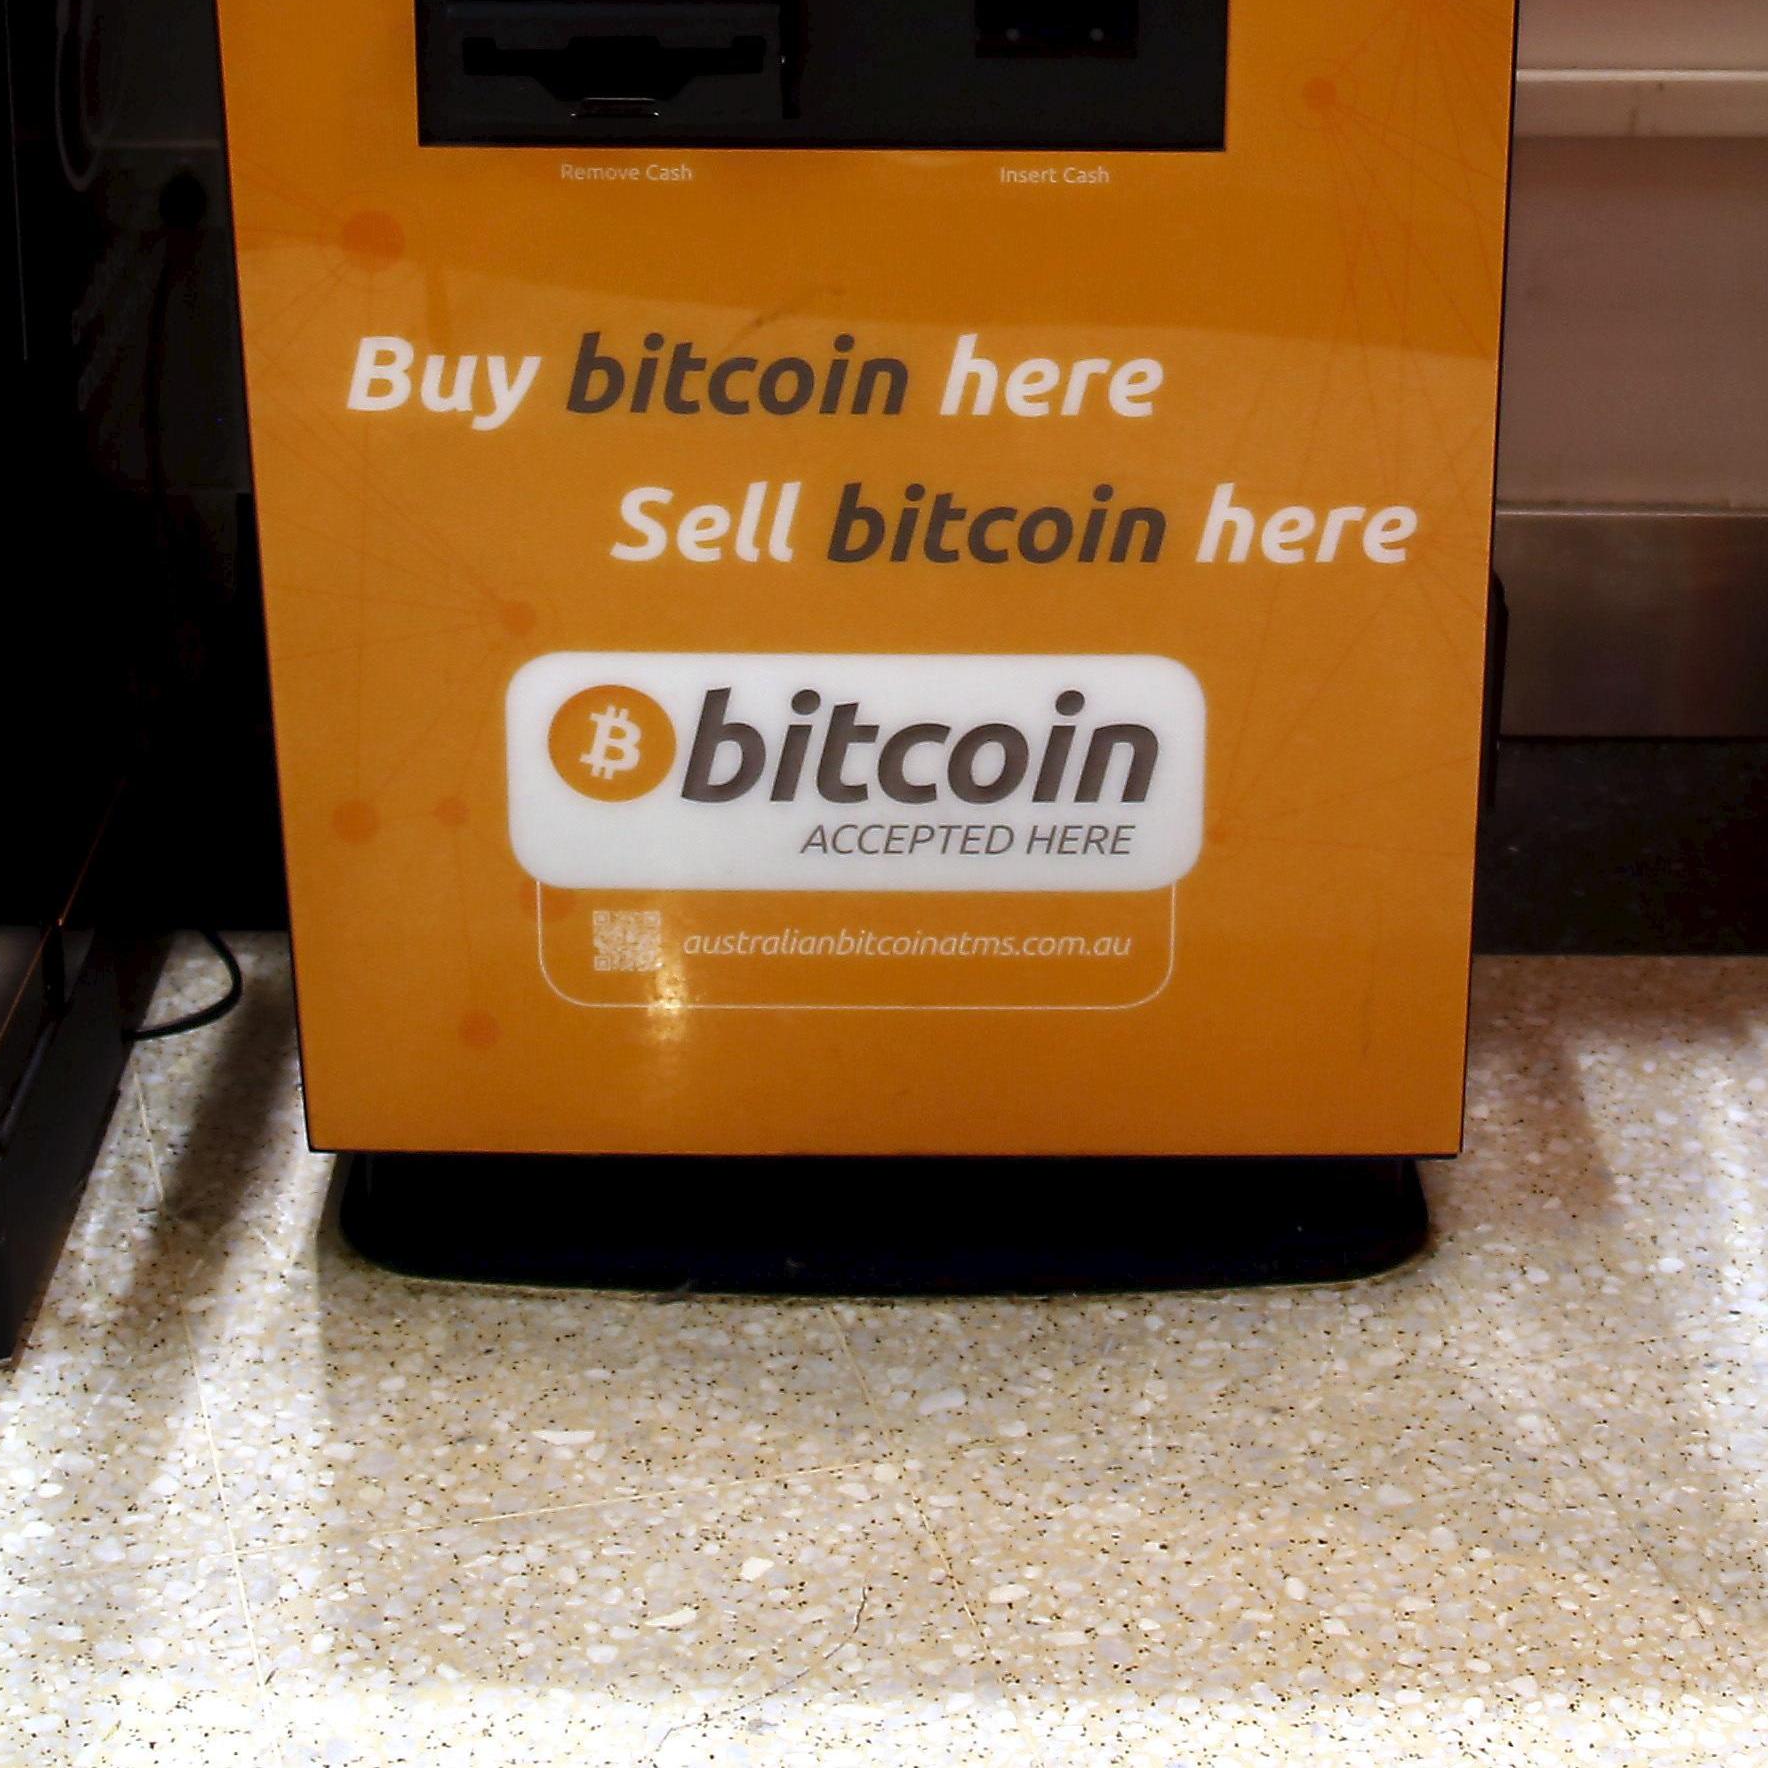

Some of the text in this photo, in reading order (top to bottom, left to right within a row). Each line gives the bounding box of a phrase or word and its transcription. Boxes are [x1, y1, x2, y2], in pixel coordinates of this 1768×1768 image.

[559, 162, 693, 183] Remove Cash
[1000, 165, 1111, 186] Insert Cash
[346, 331, 1164, 431] Buy bitcoin here
[611, 482, 1419, 564] Sell bitcoin here
[680, 687, 1160, 805] bitcoin
[800, 824, 1136, 856] ACCEPTED HERE
[683, 929, 1132, 957] australianbitcoinatms.com.au
